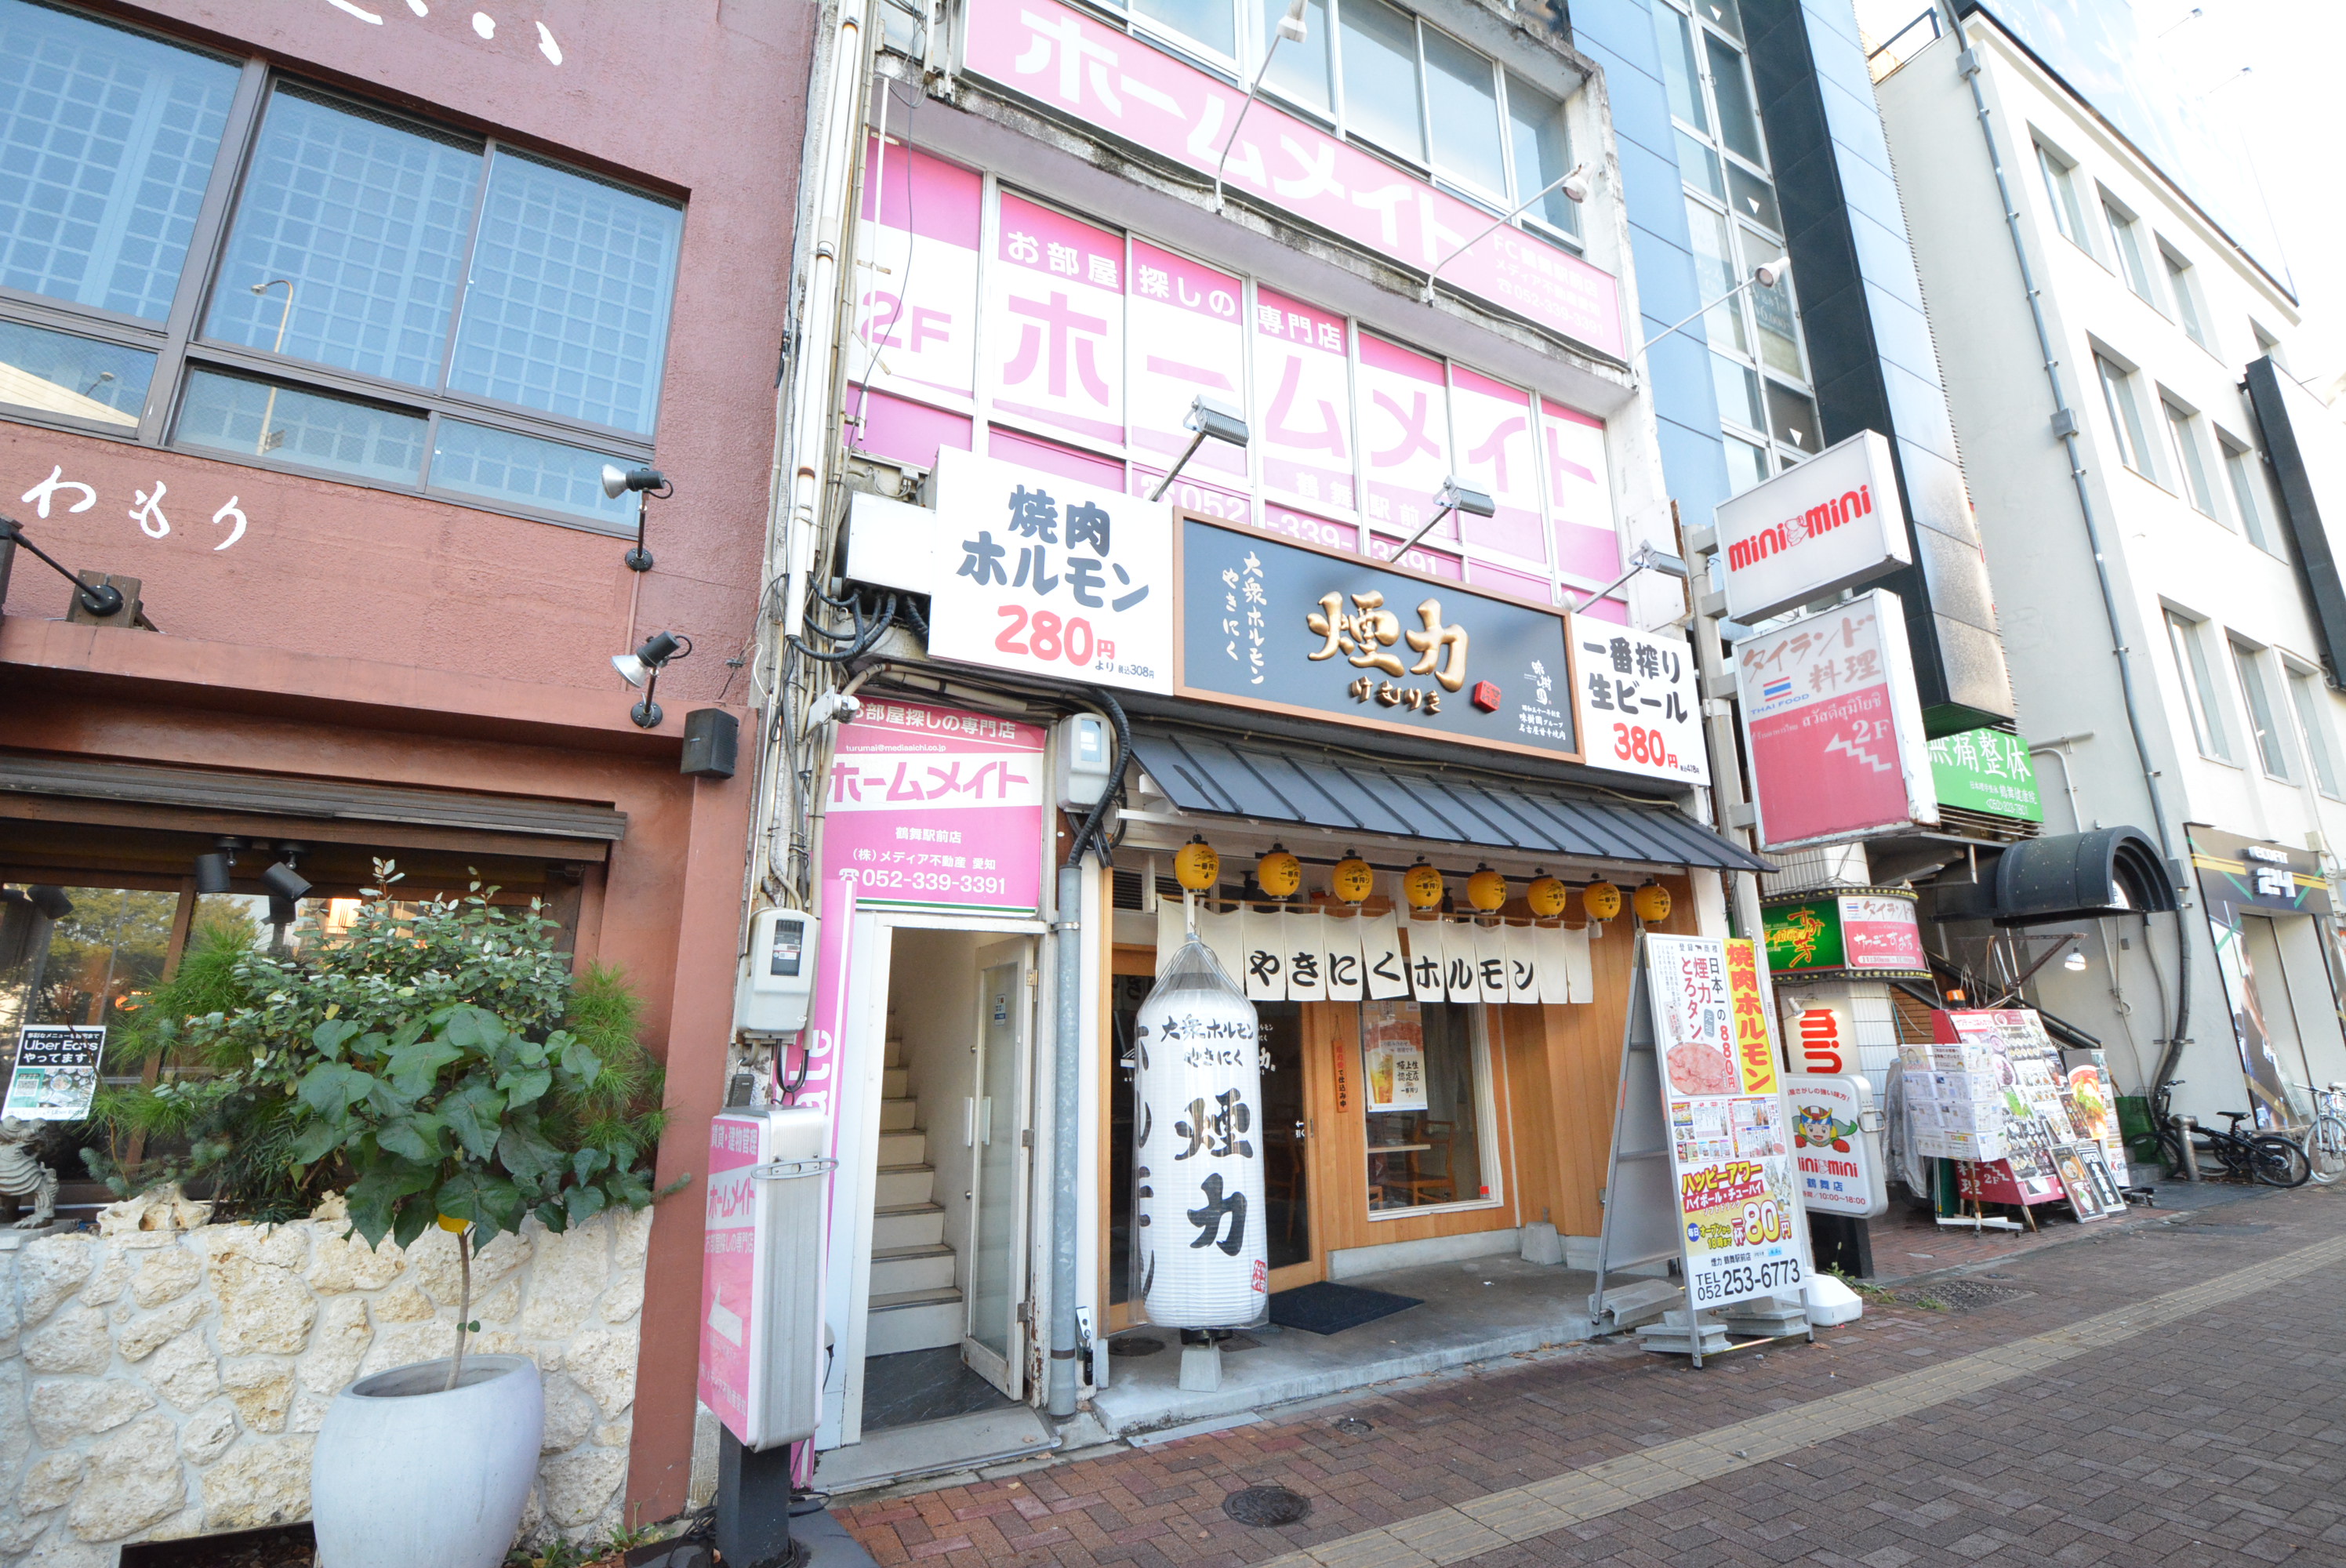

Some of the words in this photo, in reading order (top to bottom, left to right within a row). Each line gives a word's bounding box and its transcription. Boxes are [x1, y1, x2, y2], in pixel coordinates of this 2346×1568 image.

[1015, 8, 1473, 269] ホームメイト
[861, 290, 951, 353] 2F
[1003, 292, 1596, 507] ホームメイト
[1008, 484, 1110, 557] 焼肉
[1806, 484, 1872, 539] mini
[956, 530, 1149, 612] ホルモン
[1222, 568, 1240, 662] やきにく
[1243, 551, 1267, 684] 大衆ホルモン
[994, 604, 1116, 666] 280円
[1742, 614, 1876, 684] タイランド
[1095, 660, 1114, 672] より
[1583, 637, 1680, 684] 一番搾り
[1808, 648, 1882, 693] 料理
[1349, 676, 1443, 715] けむりき
[1588, 673, 1688, 724] 生ビール
[1750, 702, 1776, 716] THAI
[1778, 693, 1810, 707] FOOD
[1613, 722, 1678, 769] 380円
[1852, 719, 1890, 745] 2F
[1929, 730, 2032, 782] 無痛整体
[829, 760, 1030, 804] ホームメイト
[895, 826, 962, 844] 鶴舞駅前店
[862, 869, 1006, 895] 052-339-3391
[972, 857, 997, 871] 愛知
[2257, 866, 2297, 898] 24
[1249, 949, 1534, 990] やきにくホルモン
[1694, 956, 1712, 1004] 煙力
[1681, 956, 1702, 1040] とろタン
[1709, 957, 1727, 1021] 日本一の
[1160, 1013, 1255, 1043] 大衆ホルモン
[1727, 944, 1771, 1092] 焼肉ホルモン
[24, 1040, 61, 1051] Uber
[1184, 1047, 1244, 1068] やきにく
[1681, 1161, 1763, 1194] ハッピーアワー
[1807, 1178, 1843, 1192] 鶴舞店
[1828, 1160, 1858, 1178] mini
[1983, 1174, 2000, 1185] 2F
[708, 1176, 755, 1219] ホームメイト
[1686, 1181, 1762, 1210] ハイボール・チューハイ
[1703, 1200, 1741, 1216] ソフトドリンク
[705, 1232, 754, 1254] お部屋探しの専門店
[1687, 1227, 1700, 1238] 毎日
[1699, 1222, 1732, 1238] オープンから
[1707, 1236, 1732, 1250] 18時まで
[1695, 1271, 1721, 1286] TEL
[1698, 1283, 1722, 1301] 052
[1722, 1258, 1801, 1296] 253-6773
